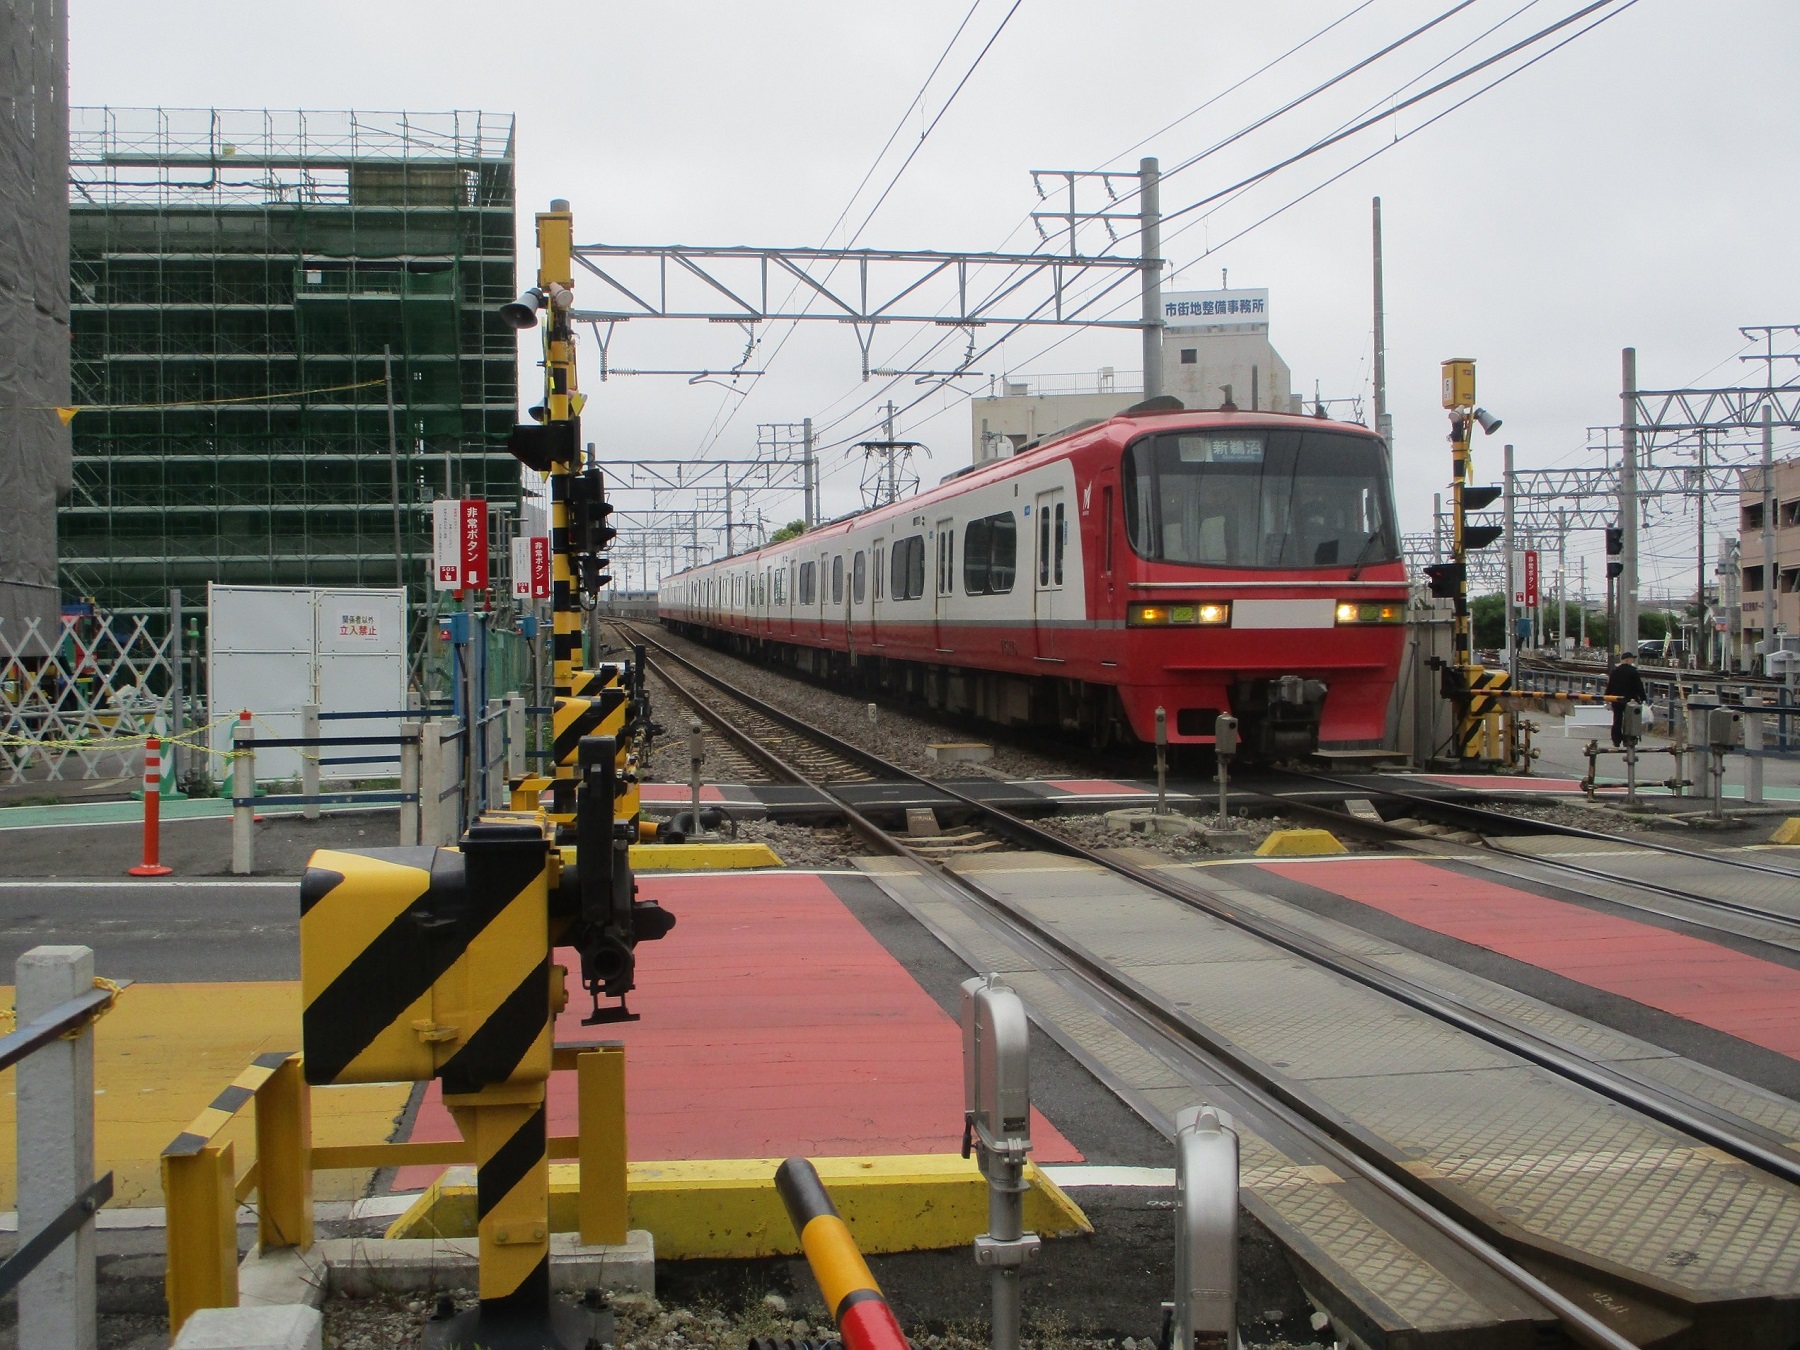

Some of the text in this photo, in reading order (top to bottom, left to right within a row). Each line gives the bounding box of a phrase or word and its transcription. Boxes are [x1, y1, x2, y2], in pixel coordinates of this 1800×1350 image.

[1165, 299, 1264, 317] 市街地整備事務所
[467, 507, 478, 562] 非常ボタン
[534, 541, 544, 580] 非常ボタン
[342, 614, 374, 624] 関係者以外
[339, 625, 378, 636] 立入禁止
[870, 708, 876, 719] 3
